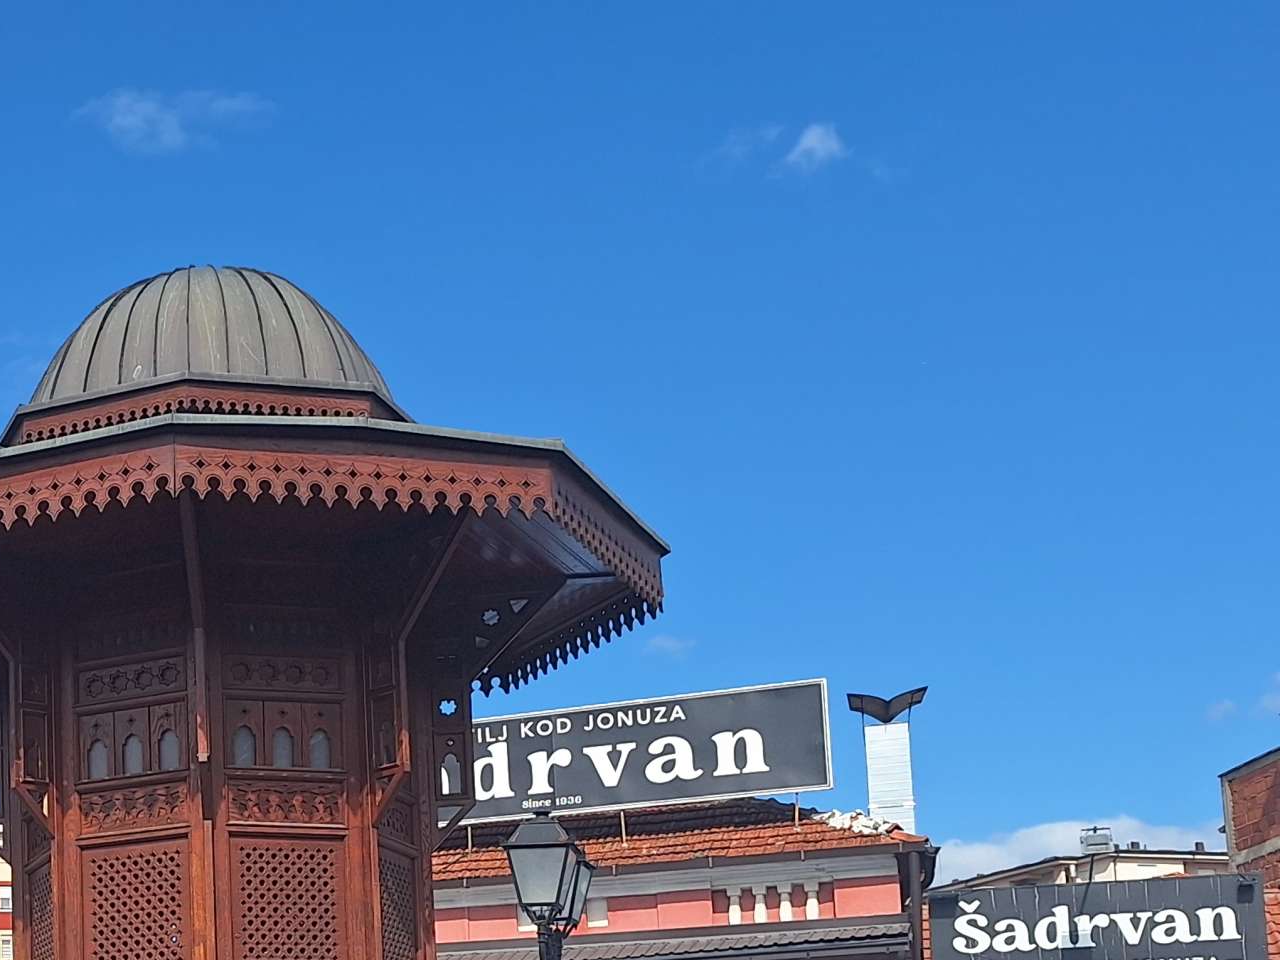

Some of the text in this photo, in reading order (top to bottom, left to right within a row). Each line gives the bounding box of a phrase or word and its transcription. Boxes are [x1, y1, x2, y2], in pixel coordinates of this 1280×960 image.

[472, 704, 687, 743] ILJ KOD JONUZA
[474, 726, 770, 801] drvan
[952, 900, 1242, 955] Šadrvan
